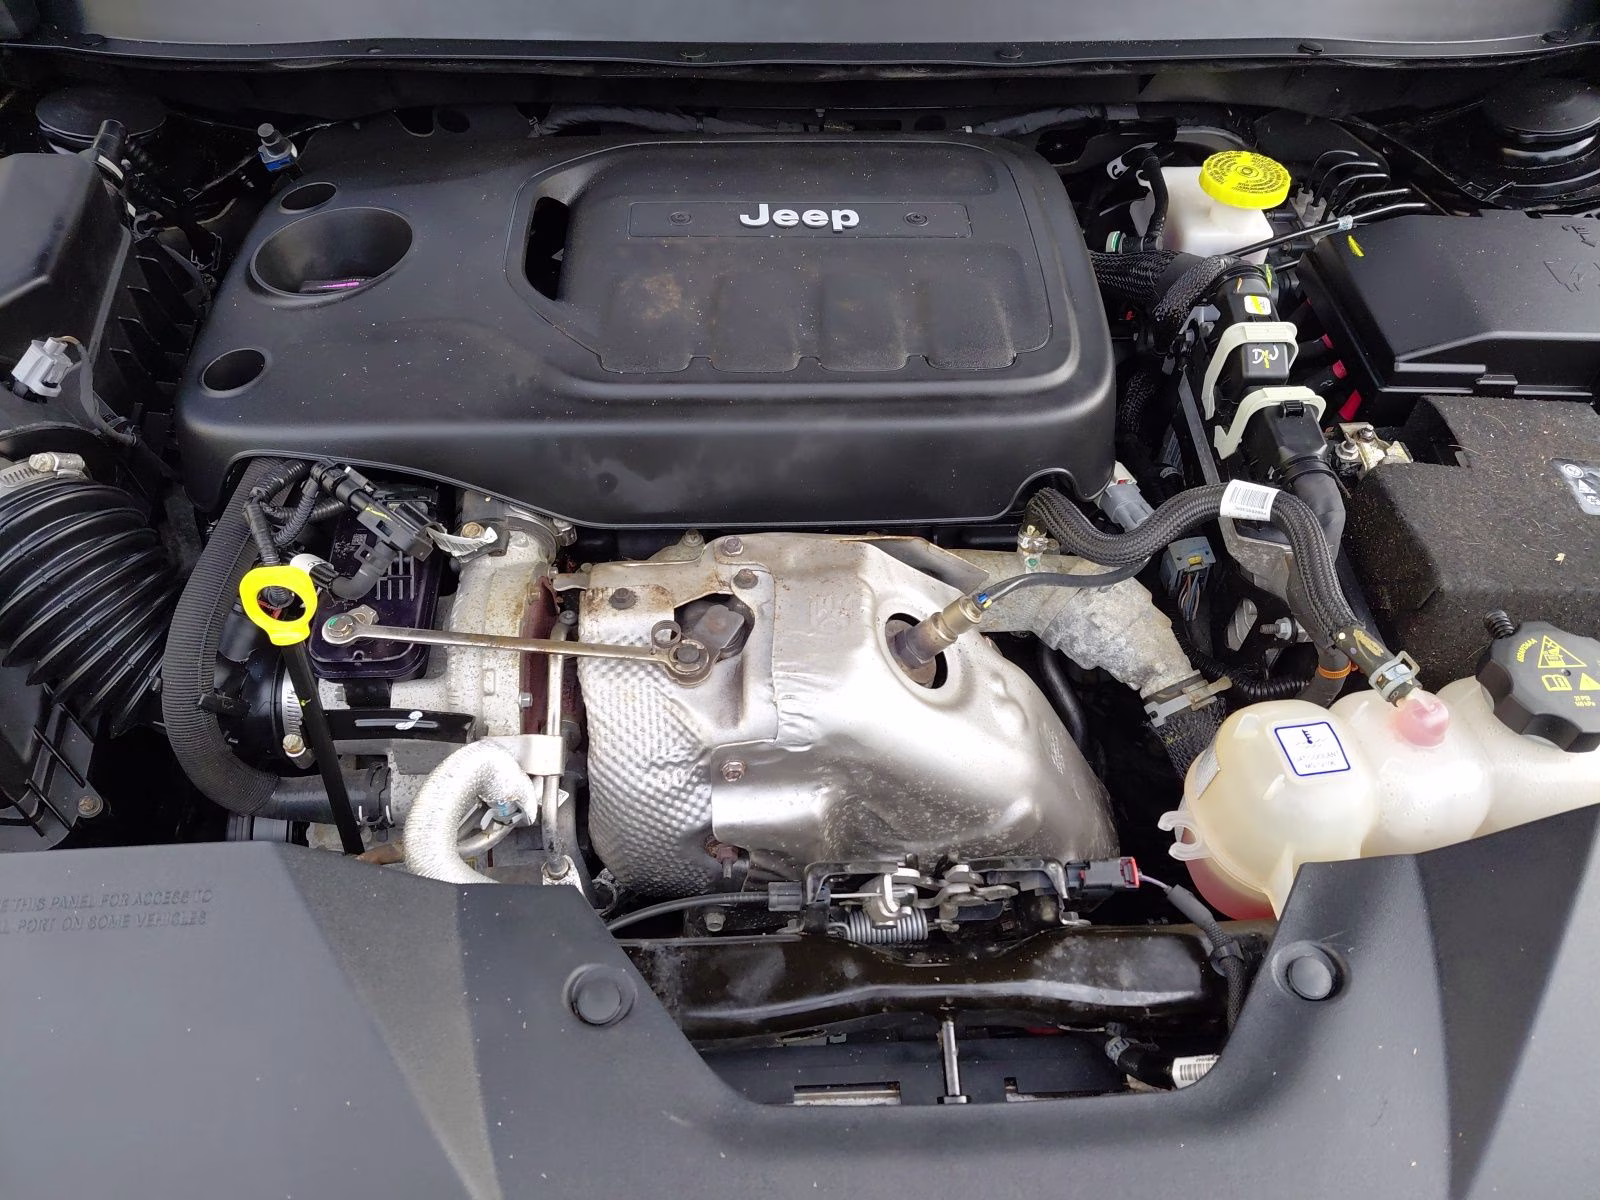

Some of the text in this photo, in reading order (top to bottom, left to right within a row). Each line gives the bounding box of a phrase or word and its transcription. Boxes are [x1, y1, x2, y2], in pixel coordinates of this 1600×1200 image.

[739, 203, 860, 232] Jeep
[14, 896, 46, 912] THIS
[49, 894, 95, 910] PANEL
[100, 893, 130, 908] FOR
[132, 890, 190, 906] ACCESS
[193, 889, 214, 904] TO
[17, 917, 54, 933] PORT
[62, 916, 82, 931] ON
[87, 914, 130, 930] SOME
[136, 911, 208, 928] VEHICLES
